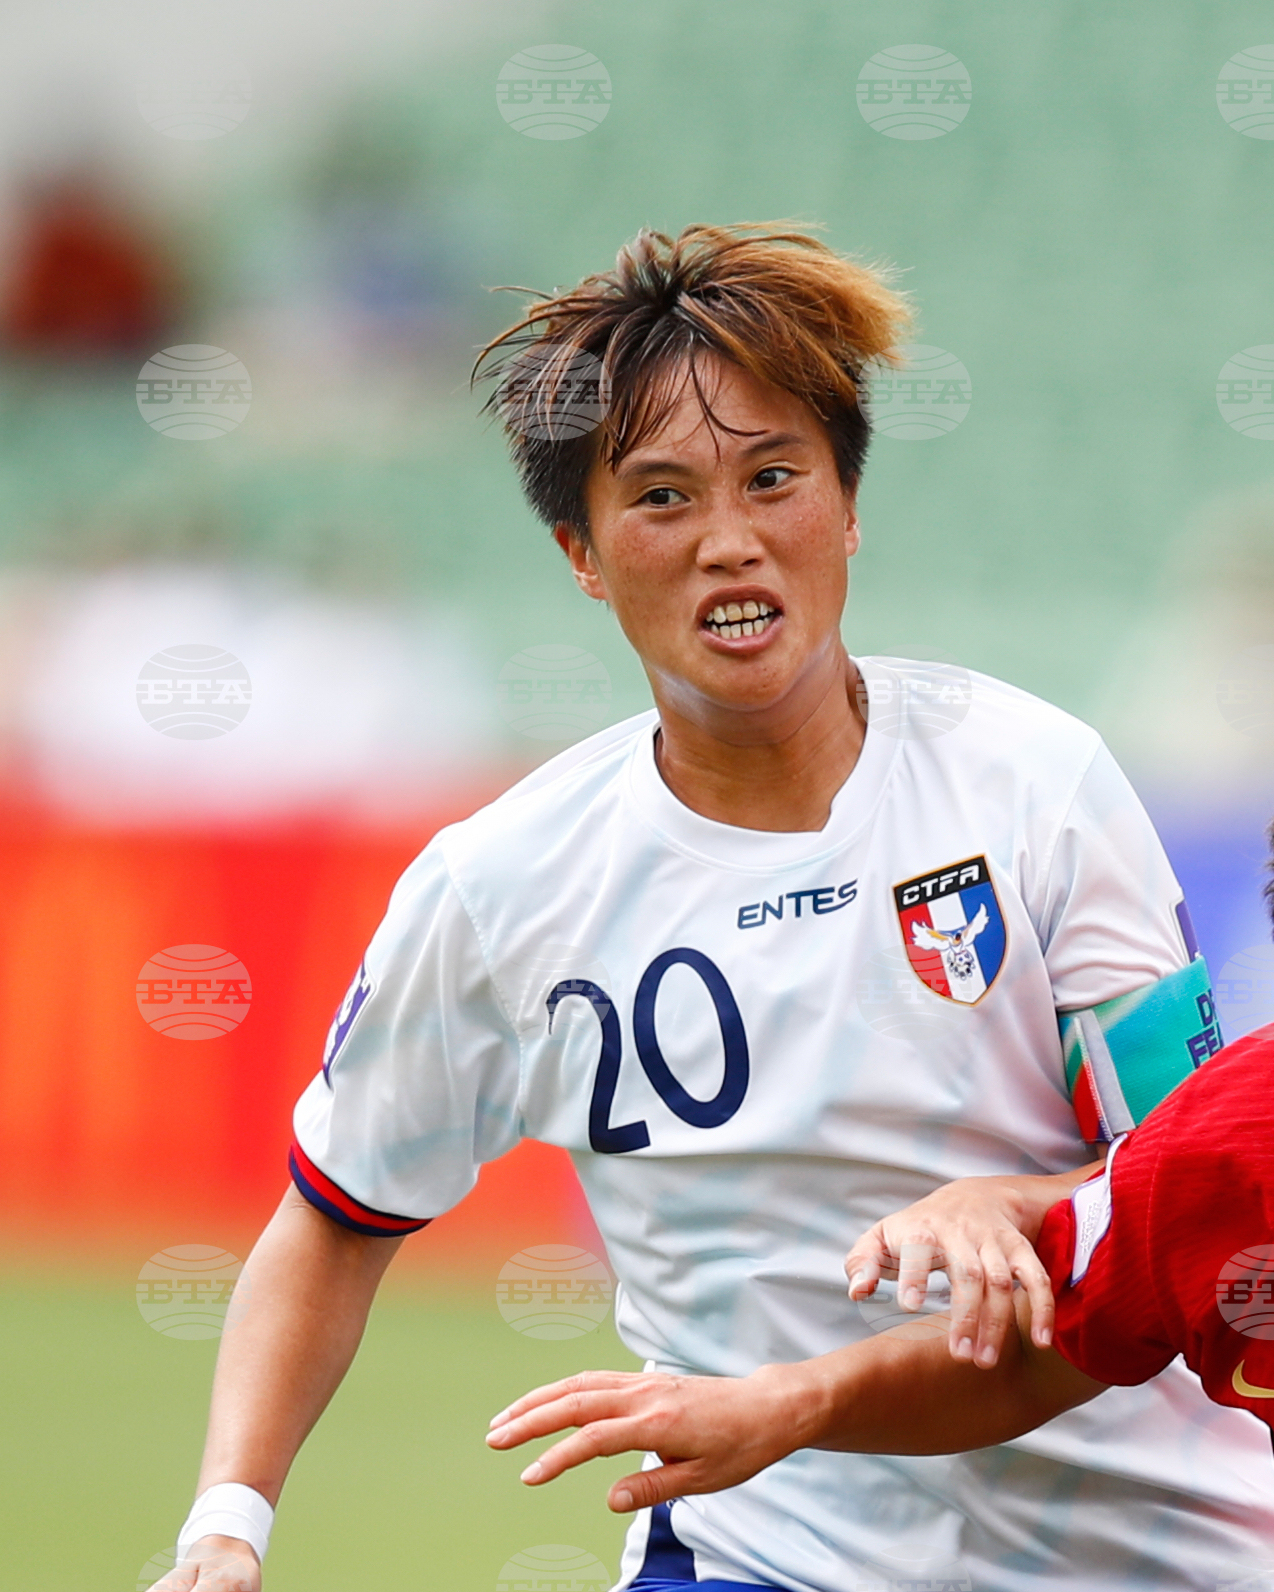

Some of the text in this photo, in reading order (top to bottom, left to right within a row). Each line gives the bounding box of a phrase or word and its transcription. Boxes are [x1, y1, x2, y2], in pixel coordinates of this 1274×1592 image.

[737, 878, 858, 930] ENTES
[902, 864, 980, 906] CTFA
[546, 946, 750, 1154] 20
